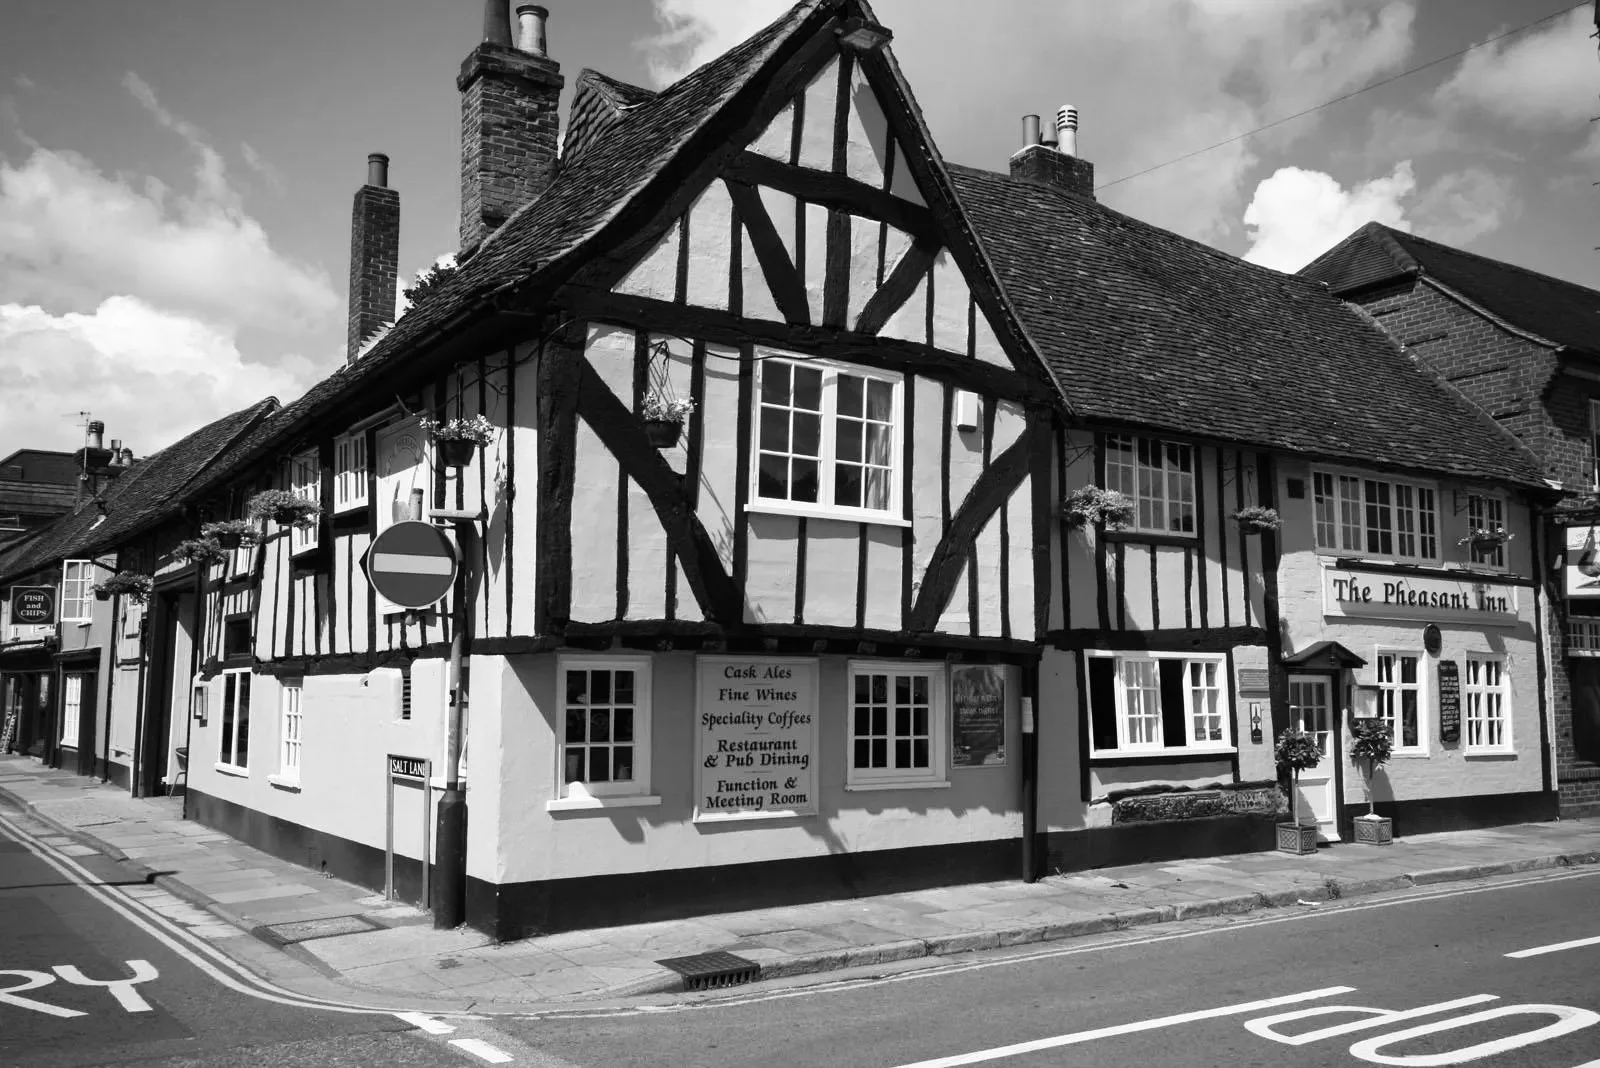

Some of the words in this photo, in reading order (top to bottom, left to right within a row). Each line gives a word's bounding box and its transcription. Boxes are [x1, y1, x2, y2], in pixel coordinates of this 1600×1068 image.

[1333, 576, 1372, 602] The
[1384, 581, 1469, 610] Pheasant
[1478, 590, 1508, 612] Inn
[724, 665, 756, 679] Cask
[763, 665, 792, 679] Ales
[719, 688, 749, 701] Fine
[756, 688, 797, 701] Wines
[702, 711, 763, 731] Speciality
[768, 710, 811, 729] Coffees
[717, 739, 797, 752] Restaurant
[392, 760, 408, 772] SALT
[410, 761, 425, 776] LAN
[704, 754, 718, 768] &
[725, 752, 754, 767] Pub
[760, 751, 809, 770] Dining
[717, 777, 778, 793] Function
[784, 776, 797, 789] &
[706, 794, 763, 811] Meeting
[770, 792, 808, 805] Room
